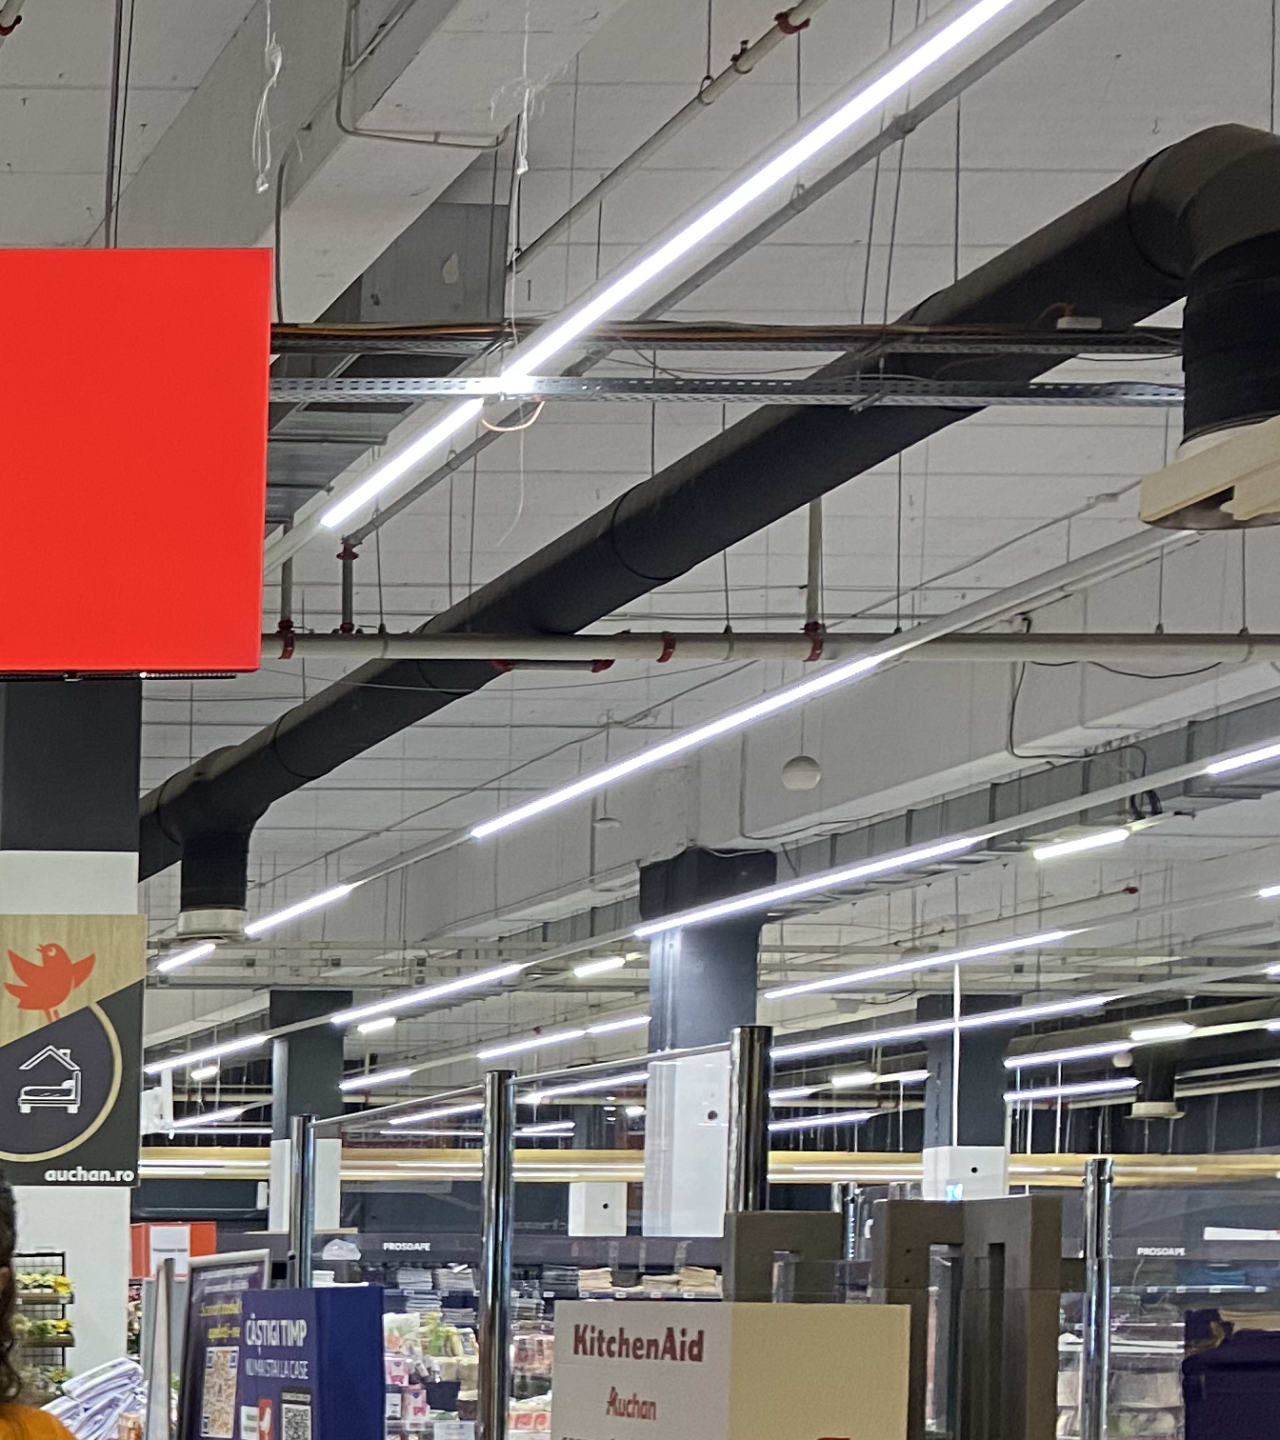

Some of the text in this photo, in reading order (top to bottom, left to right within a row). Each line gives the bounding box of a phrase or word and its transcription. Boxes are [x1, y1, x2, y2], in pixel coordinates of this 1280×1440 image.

[44, 1167, 134, 1183] auchan.ro
[281, 1319, 308, 1347] TIMP
[573, 1323, 705, 1362] KitchenAid
[290, 1360, 309, 1380] CASE
[606, 1385, 657, 1421] Auchan
